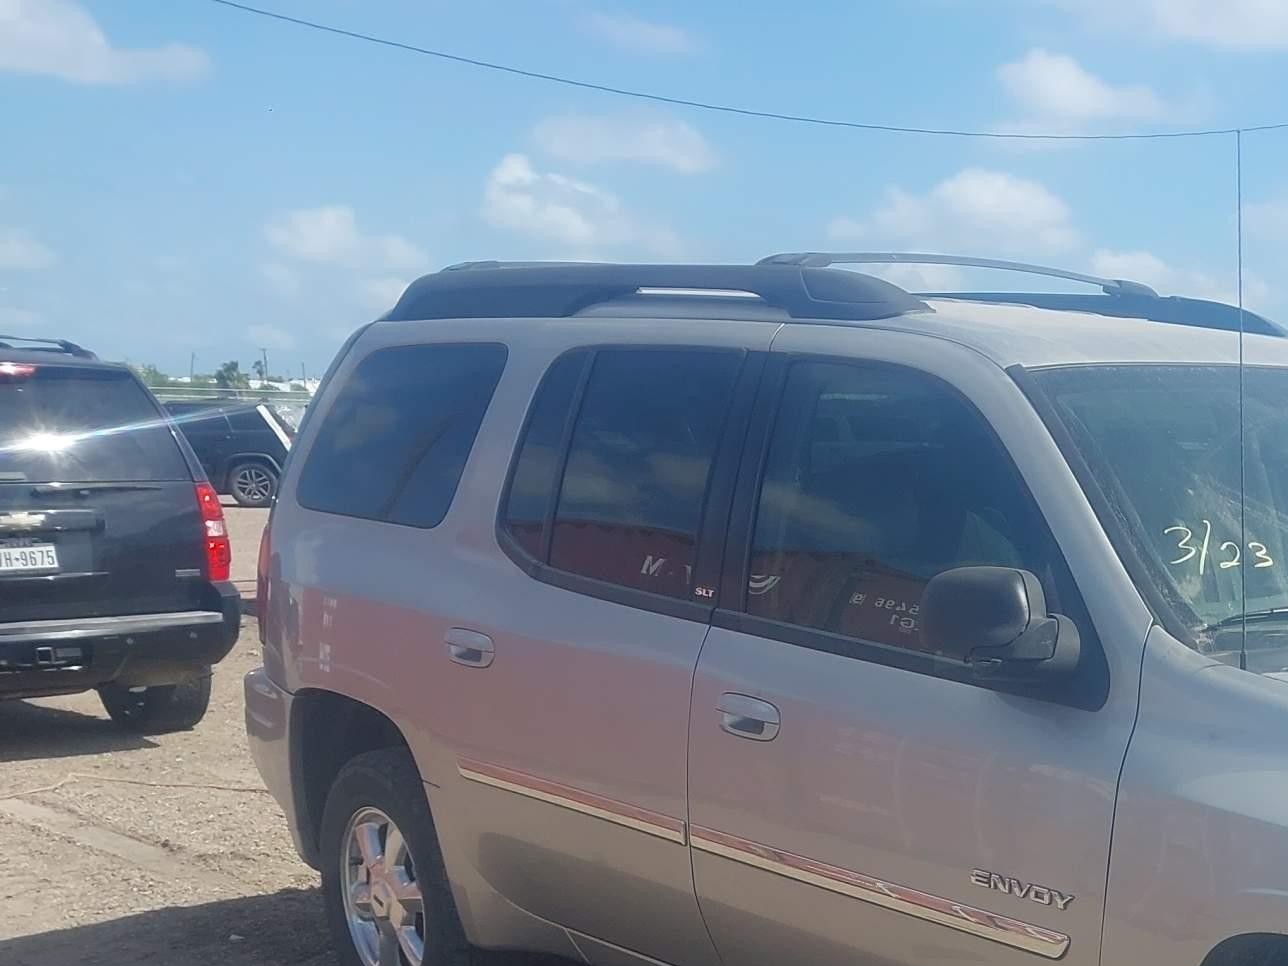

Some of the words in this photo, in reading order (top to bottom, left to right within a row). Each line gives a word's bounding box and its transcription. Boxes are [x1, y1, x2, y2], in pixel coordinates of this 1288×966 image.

[1163, 519, 1274, 576] 3/23
[695, 586, 715, 598] SLT
[969, 867, 1076, 911] ENVOY
